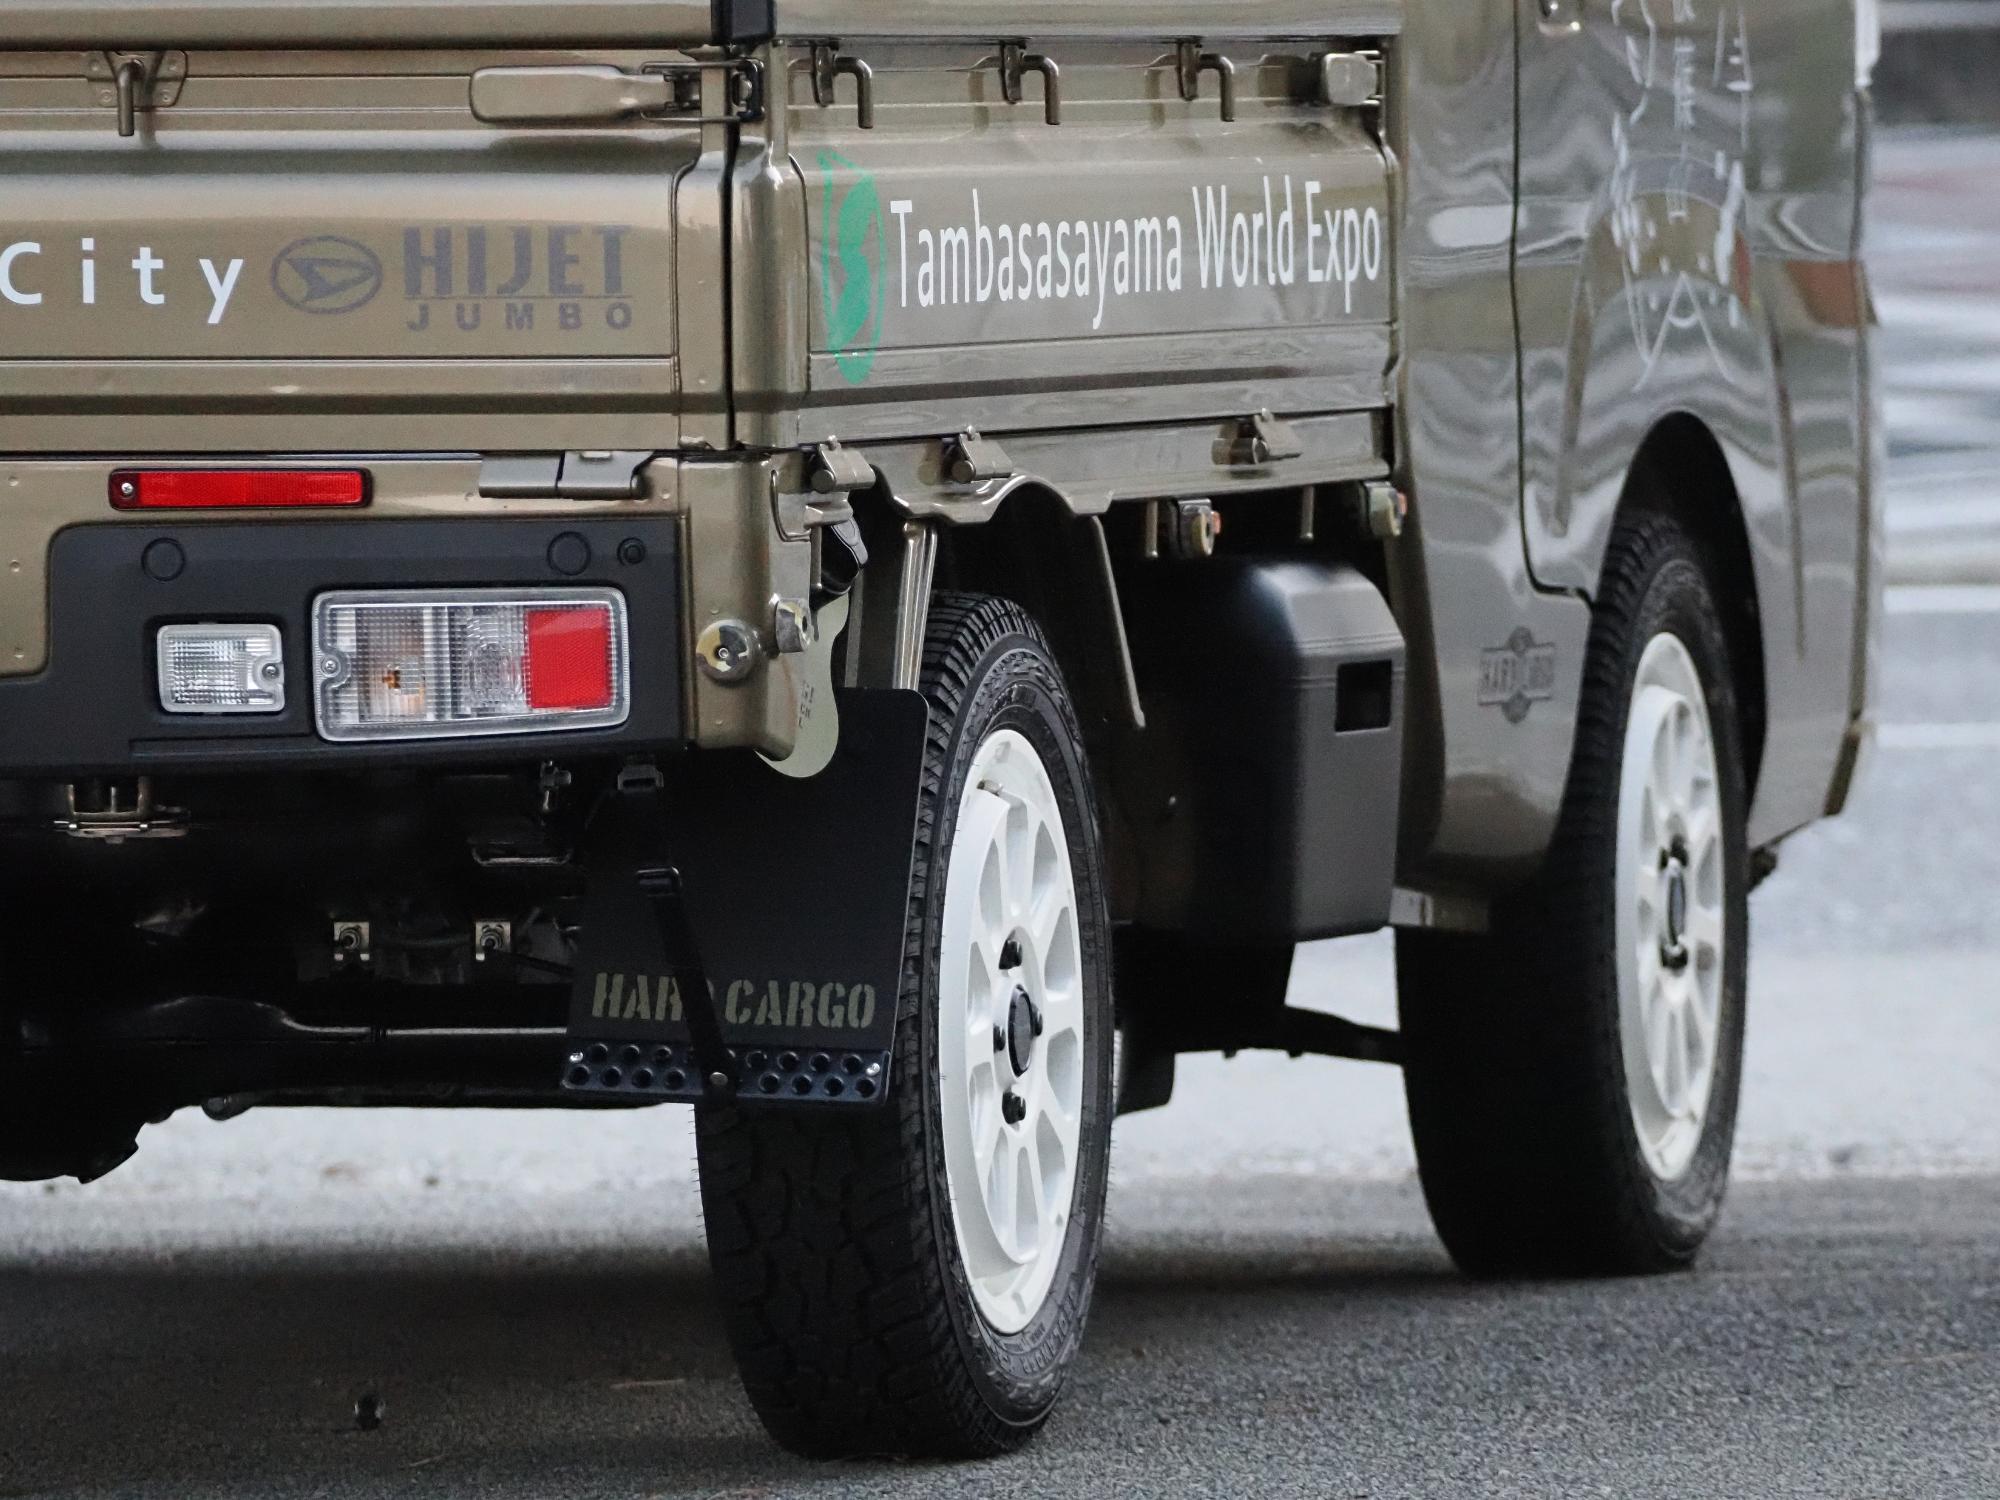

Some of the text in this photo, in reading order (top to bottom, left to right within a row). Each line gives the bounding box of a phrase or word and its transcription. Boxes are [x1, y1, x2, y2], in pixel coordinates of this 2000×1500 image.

[0, 236, 244, 325] City
[403, 225, 632, 295] HIJET
[889, 174, 1380, 330] Tambasasayama World Expo
[405, 302, 633, 331] JUMBO
[591, 972, 876, 1029] HAR CARGO
